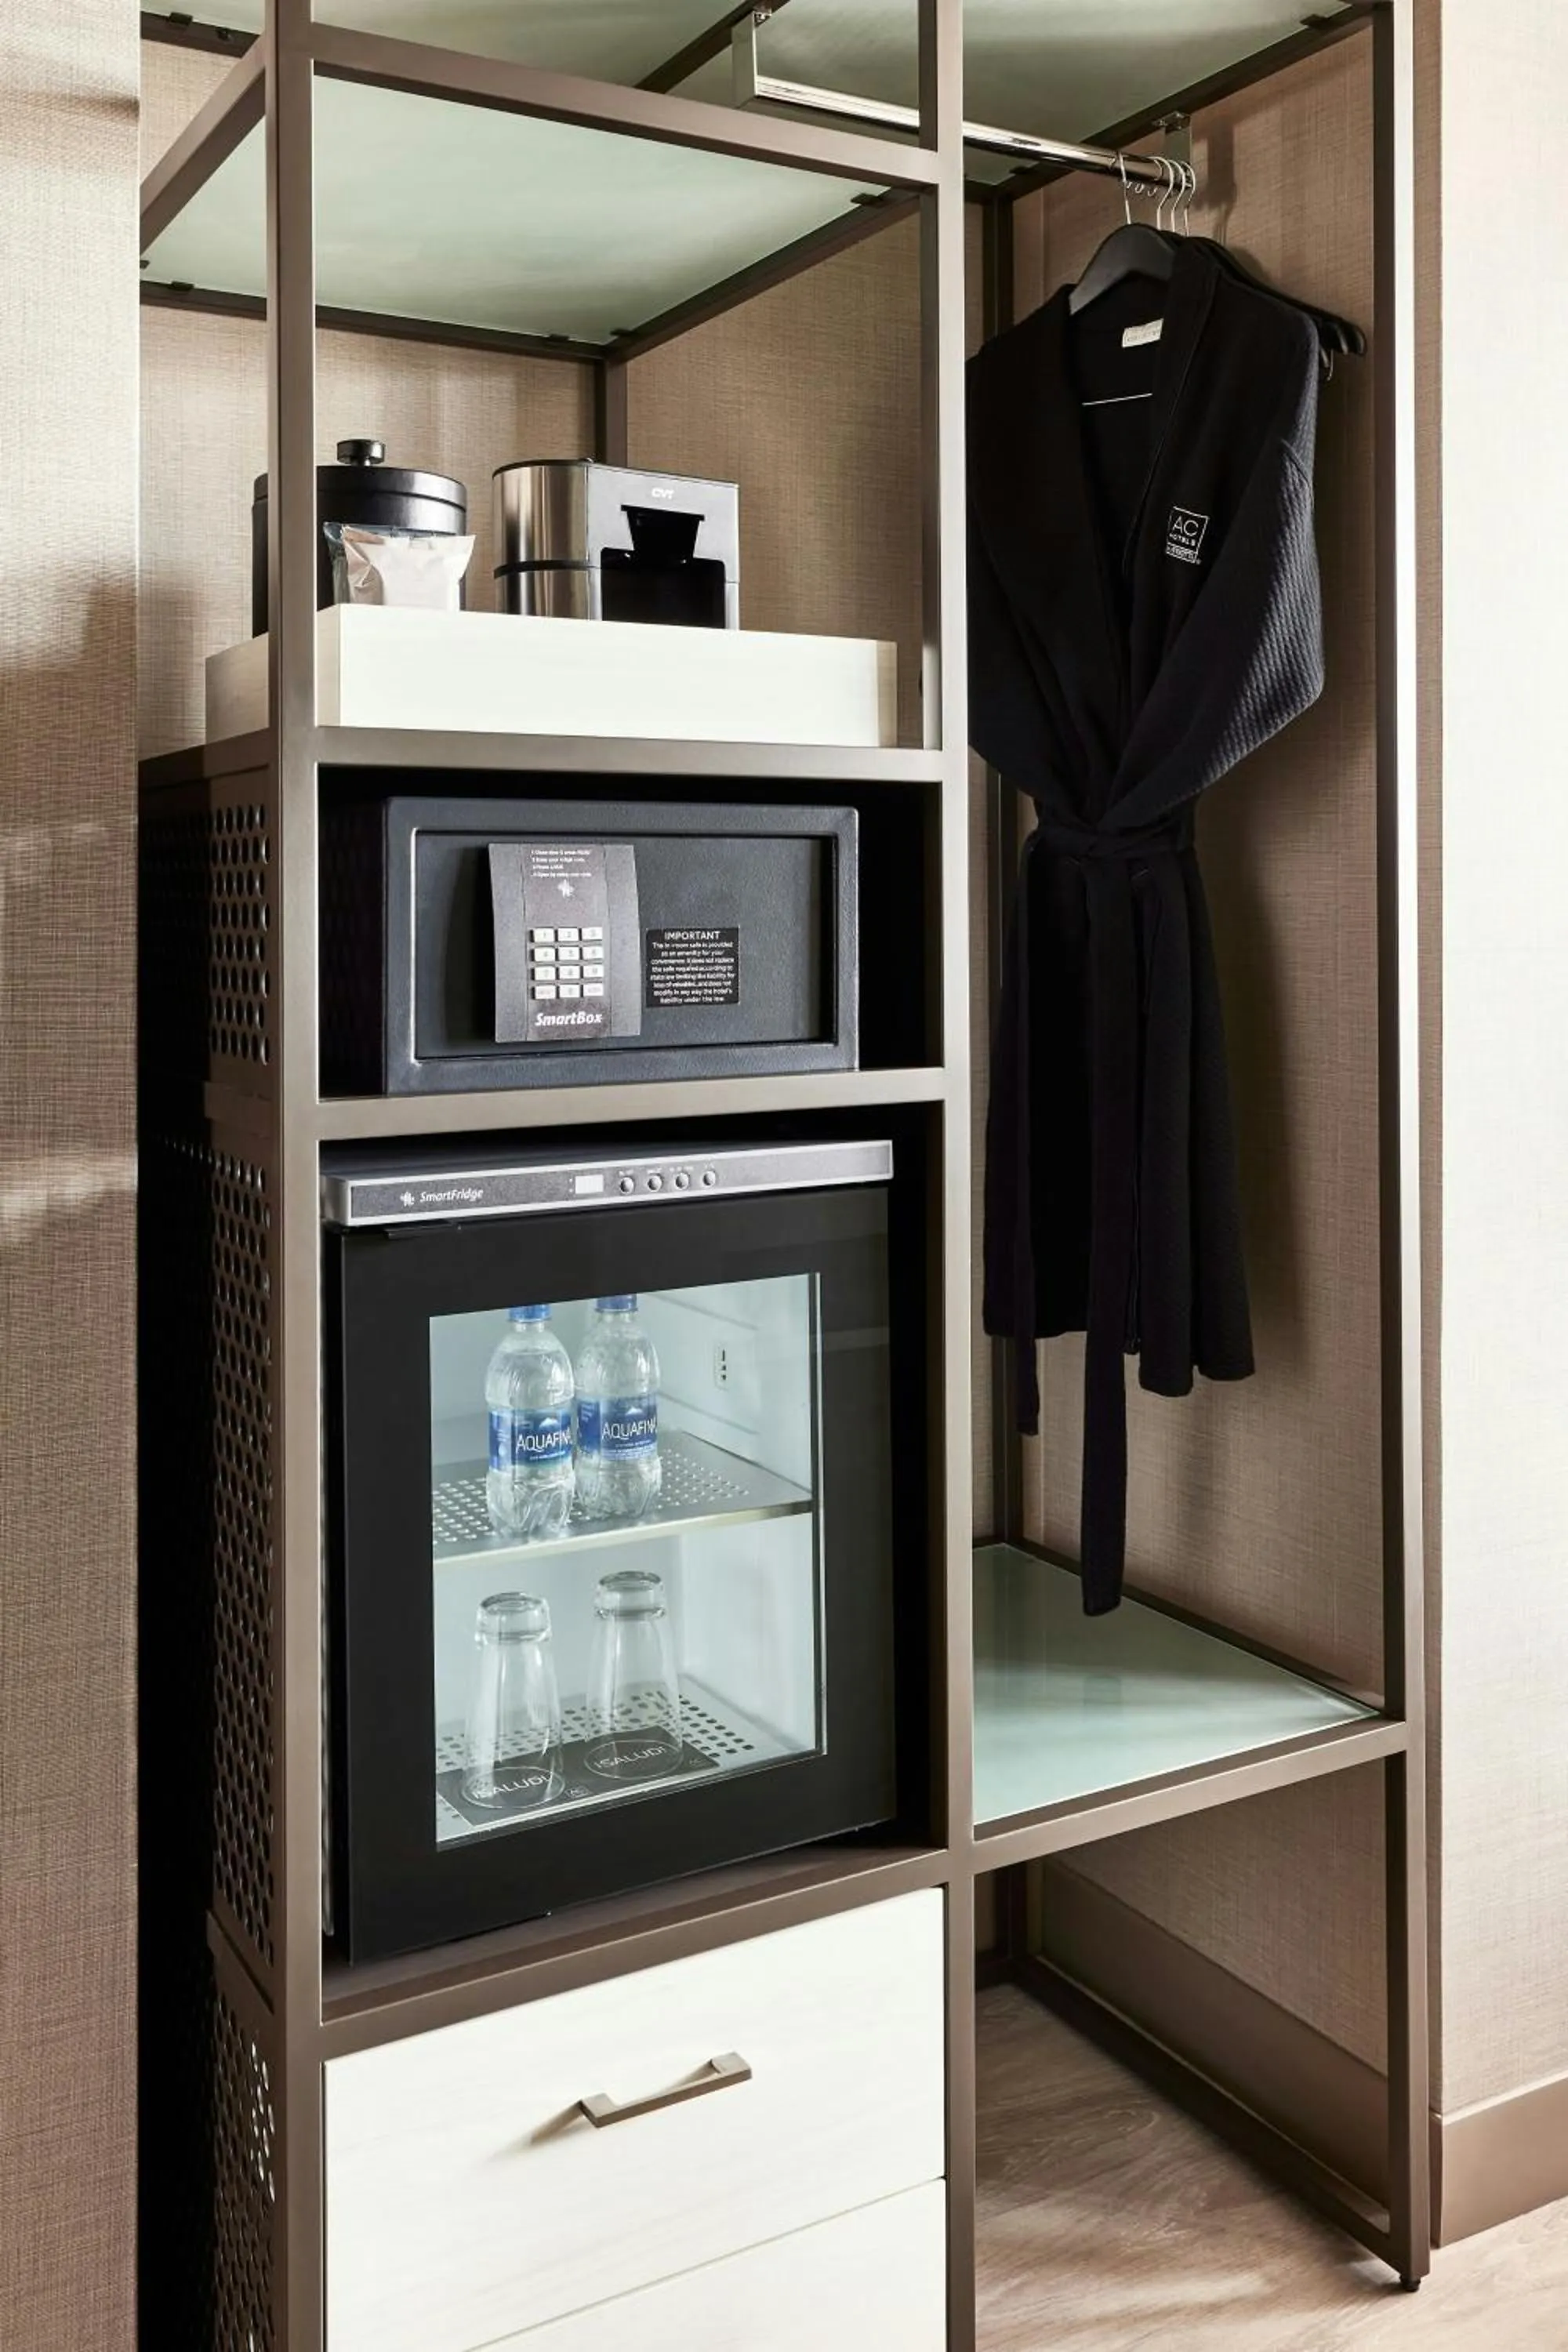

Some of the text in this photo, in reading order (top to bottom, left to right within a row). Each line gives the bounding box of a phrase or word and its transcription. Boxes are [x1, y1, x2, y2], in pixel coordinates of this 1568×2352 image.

[1173, 515, 1199, 536] AC
[664, 931, 720, 940] IMPORTANT
[535, 1011, 603, 1026] SmartBox
[419, 1188, 484, 1203] SmartFridge
